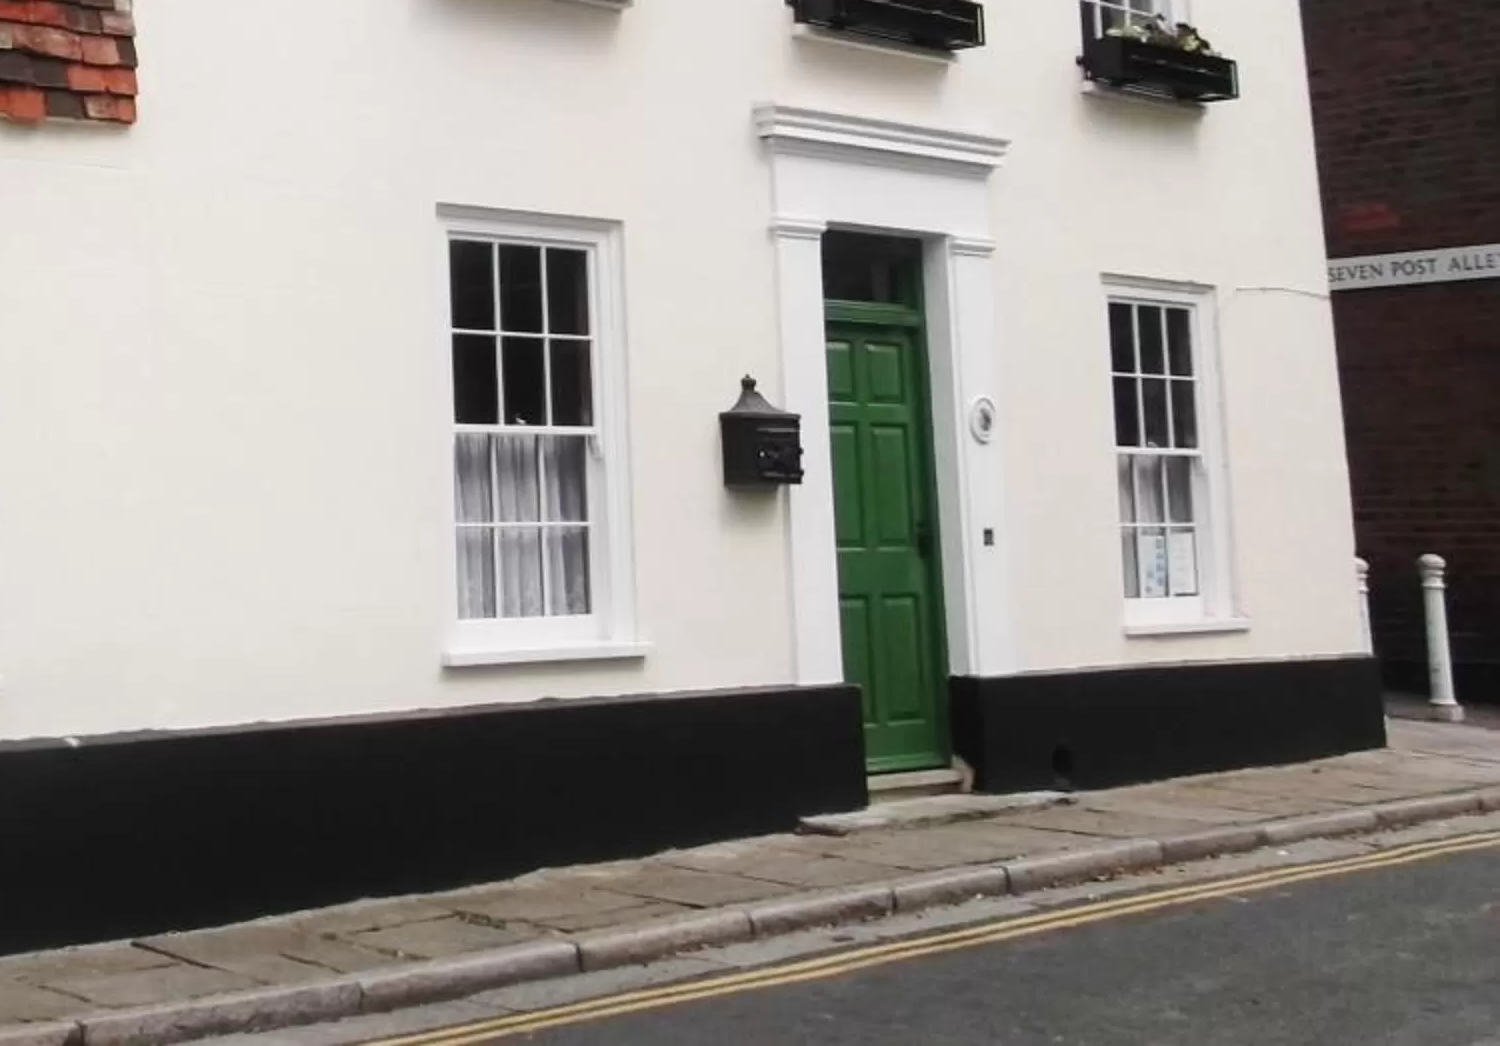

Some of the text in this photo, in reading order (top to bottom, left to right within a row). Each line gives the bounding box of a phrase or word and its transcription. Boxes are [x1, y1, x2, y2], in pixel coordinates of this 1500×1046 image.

[1327, 253, 1500, 283] SEVEN POST ALLE
